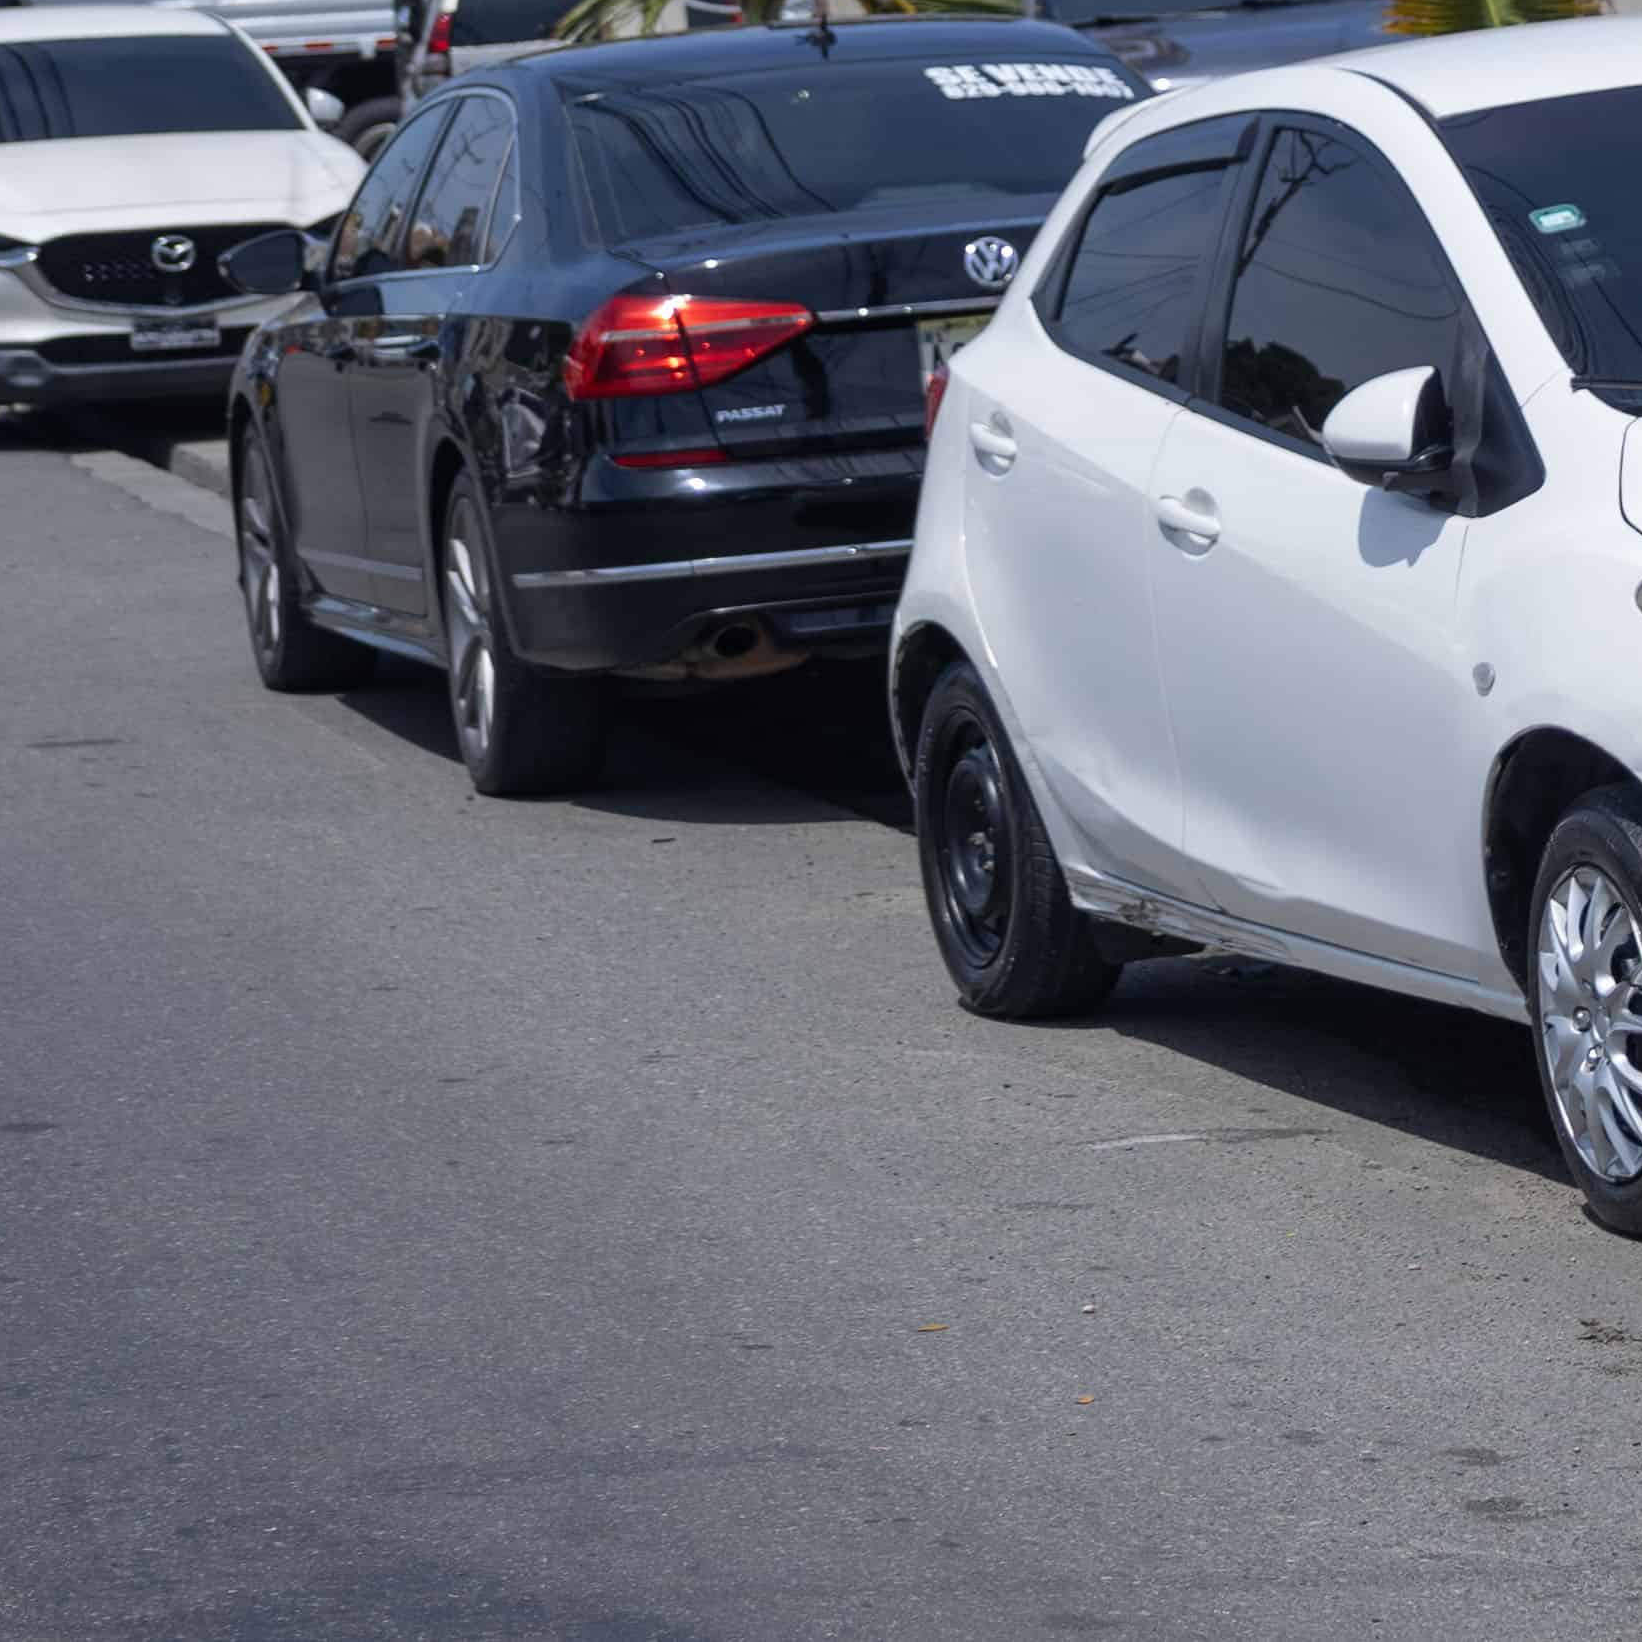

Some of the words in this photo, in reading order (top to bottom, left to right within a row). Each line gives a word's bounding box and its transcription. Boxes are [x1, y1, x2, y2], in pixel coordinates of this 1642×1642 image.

[924, 64, 988, 85] SE
[981, 62, 1125, 85] VENDE
[715, 404, 787, 423] PASSAT
